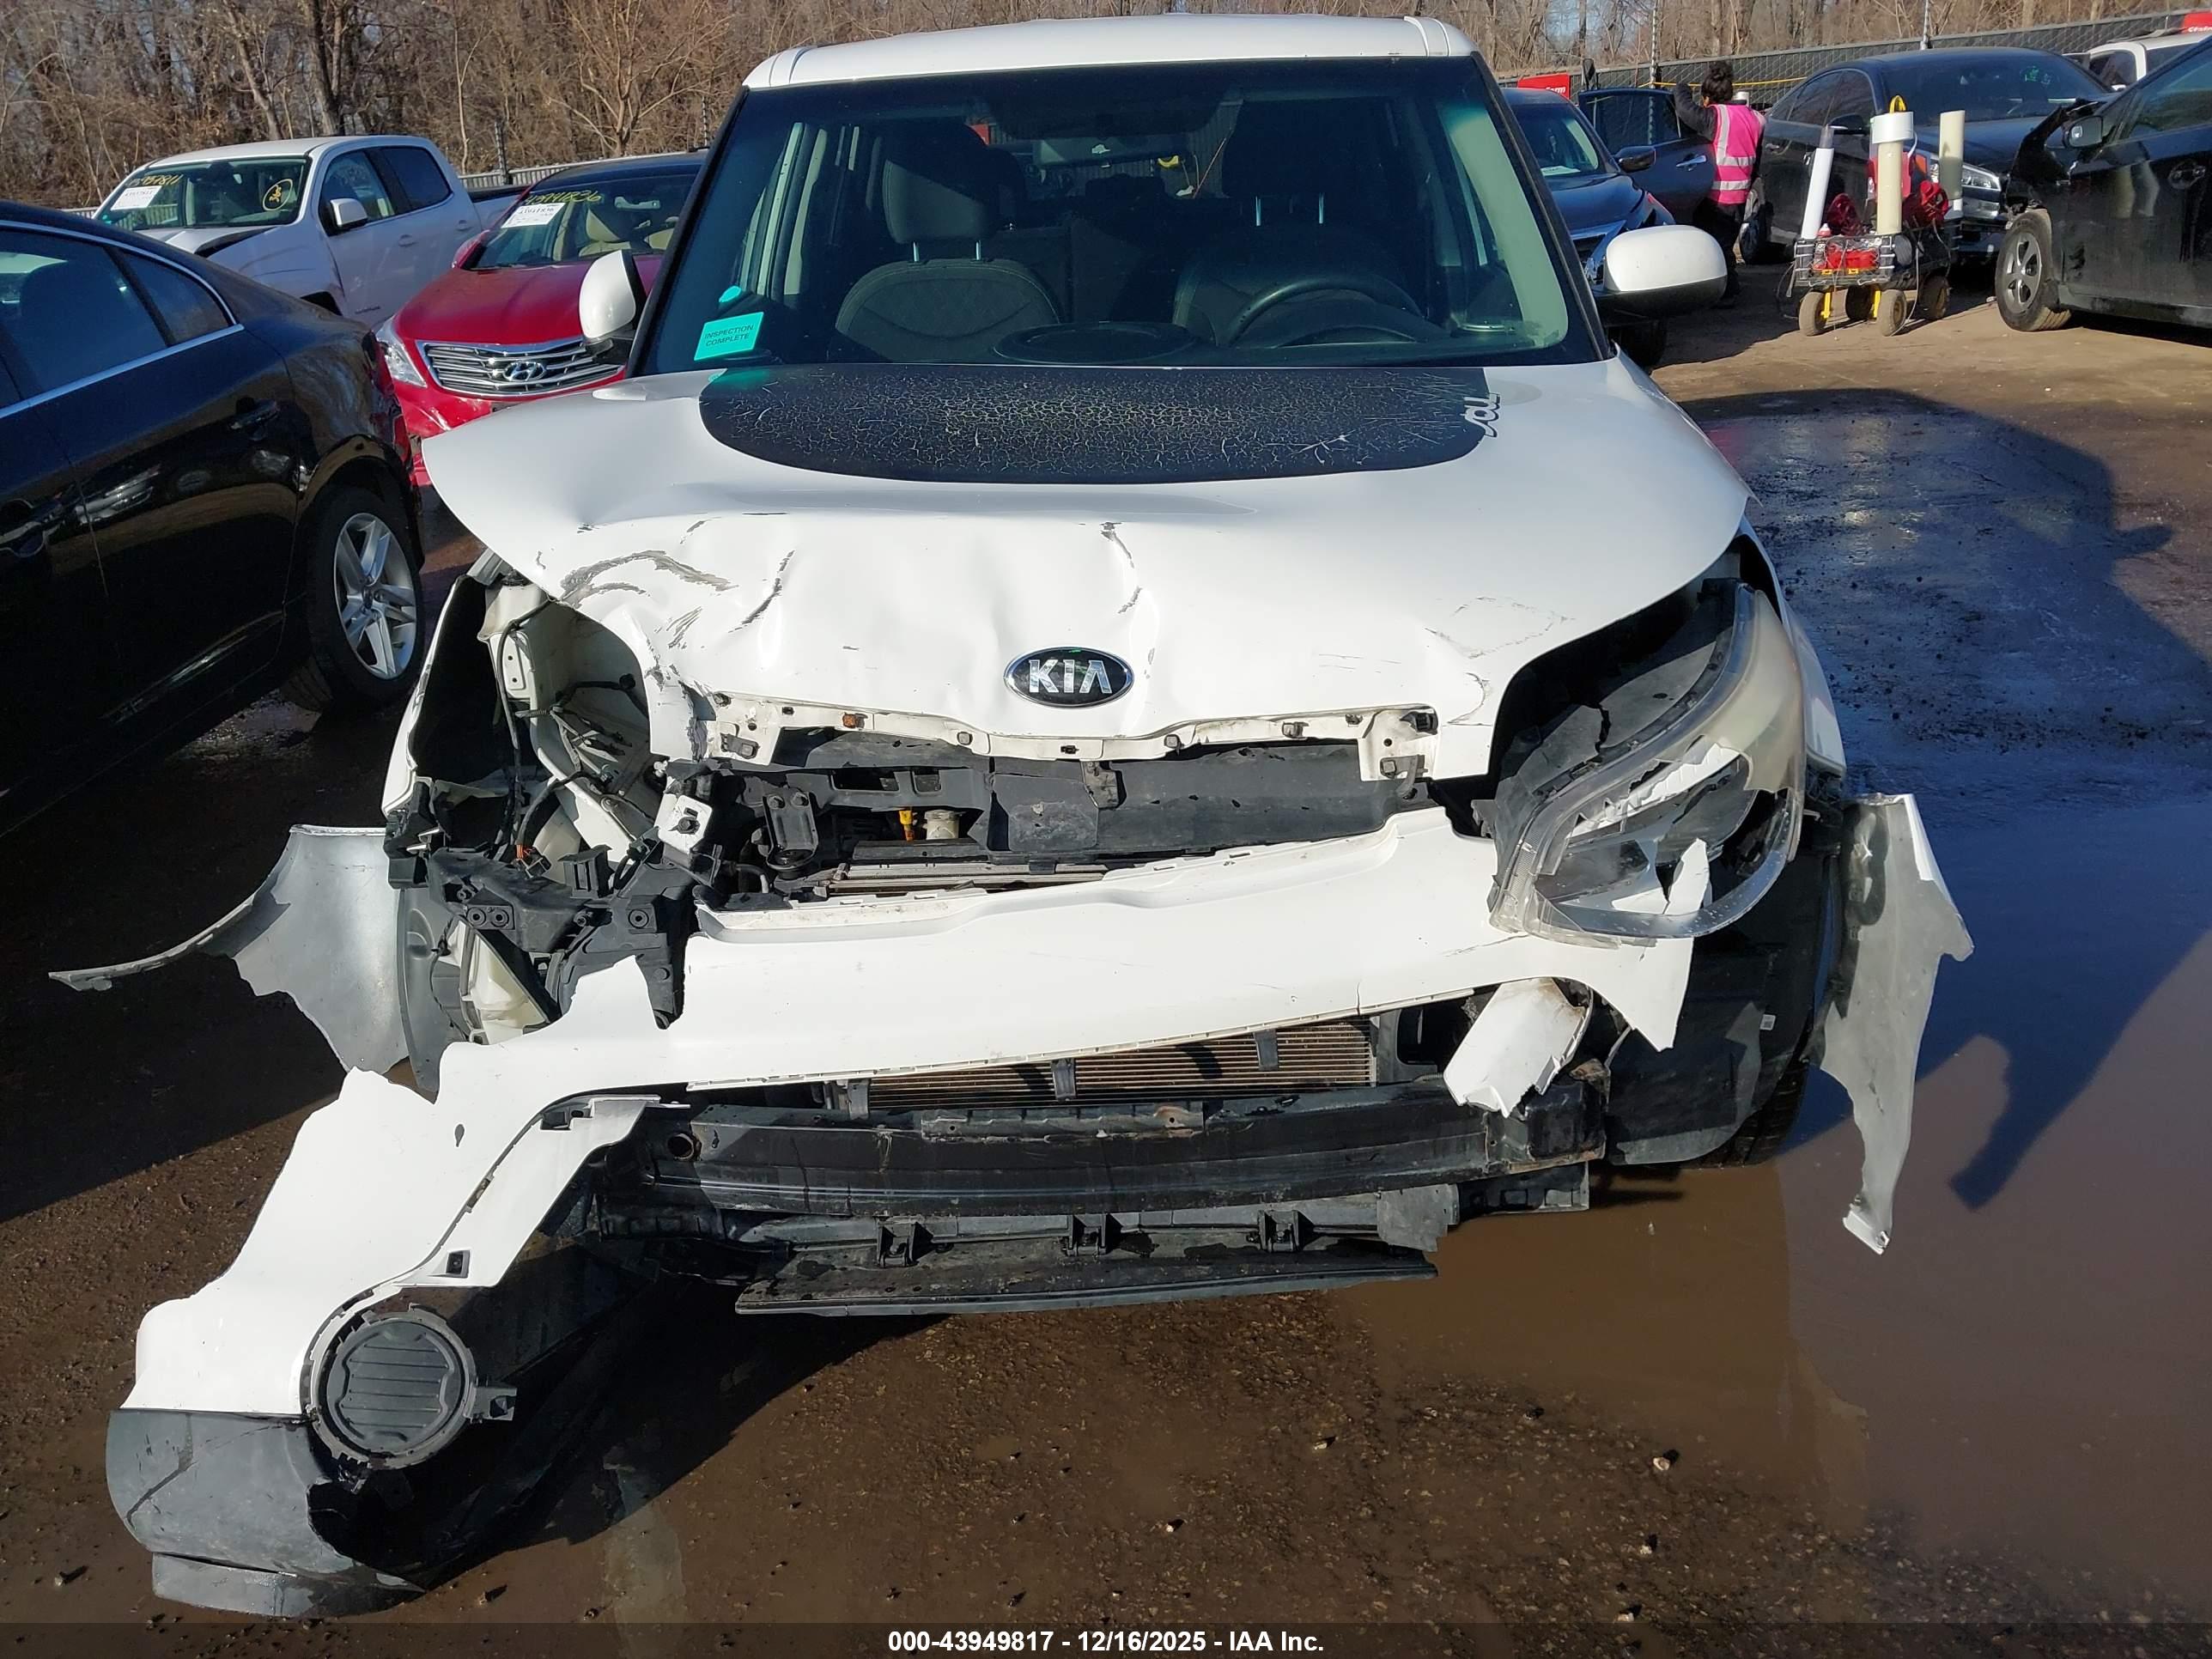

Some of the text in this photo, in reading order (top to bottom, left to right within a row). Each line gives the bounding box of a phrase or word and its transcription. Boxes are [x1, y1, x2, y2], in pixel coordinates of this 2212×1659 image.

[704, 325, 754, 339] INSPECTION
[706, 333, 750, 347] COMPLETE
[1029, 659, 1113, 694] KIA
